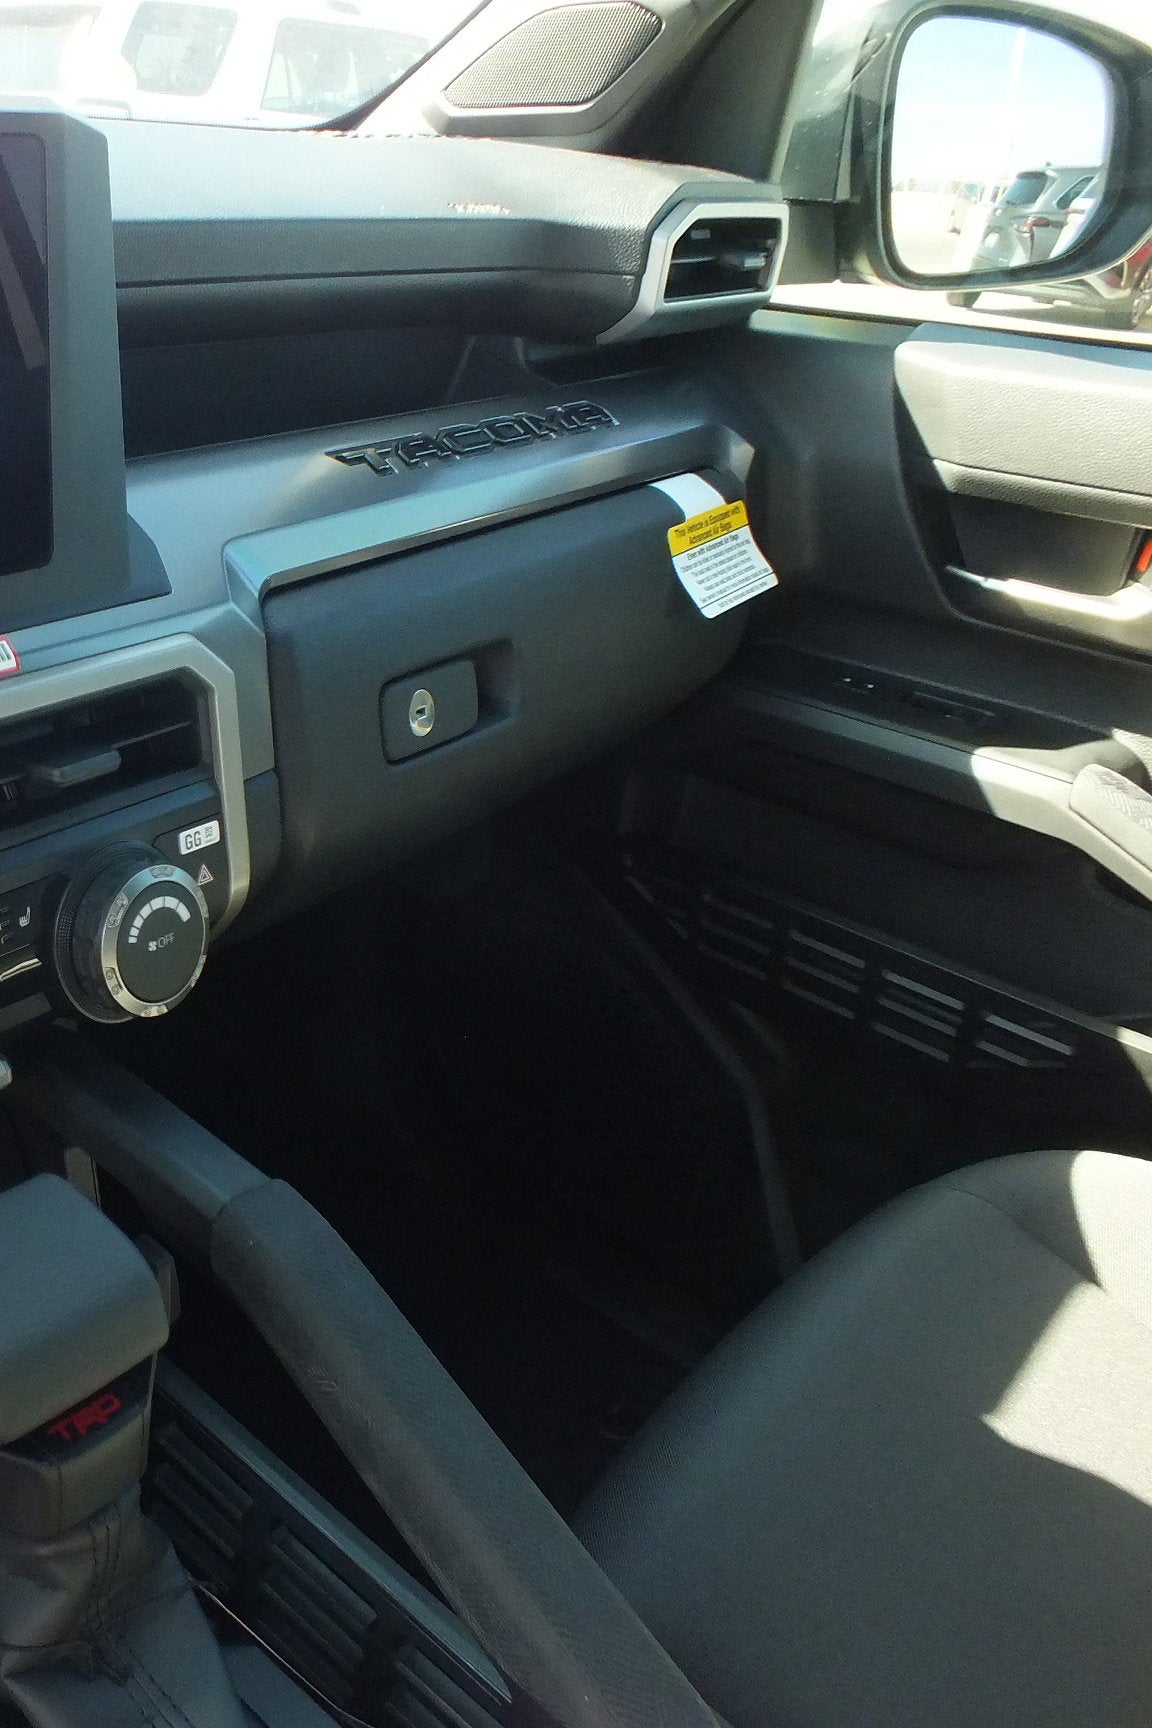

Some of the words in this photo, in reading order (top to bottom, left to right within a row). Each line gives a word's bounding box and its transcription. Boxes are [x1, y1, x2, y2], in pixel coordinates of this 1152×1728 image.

[323, 400, 621, 477] TACOMA
[184, 830, 202, 850] GG
[158, 932, 175, 948] OFF
[47, 1392, 123, 1440] TRD
